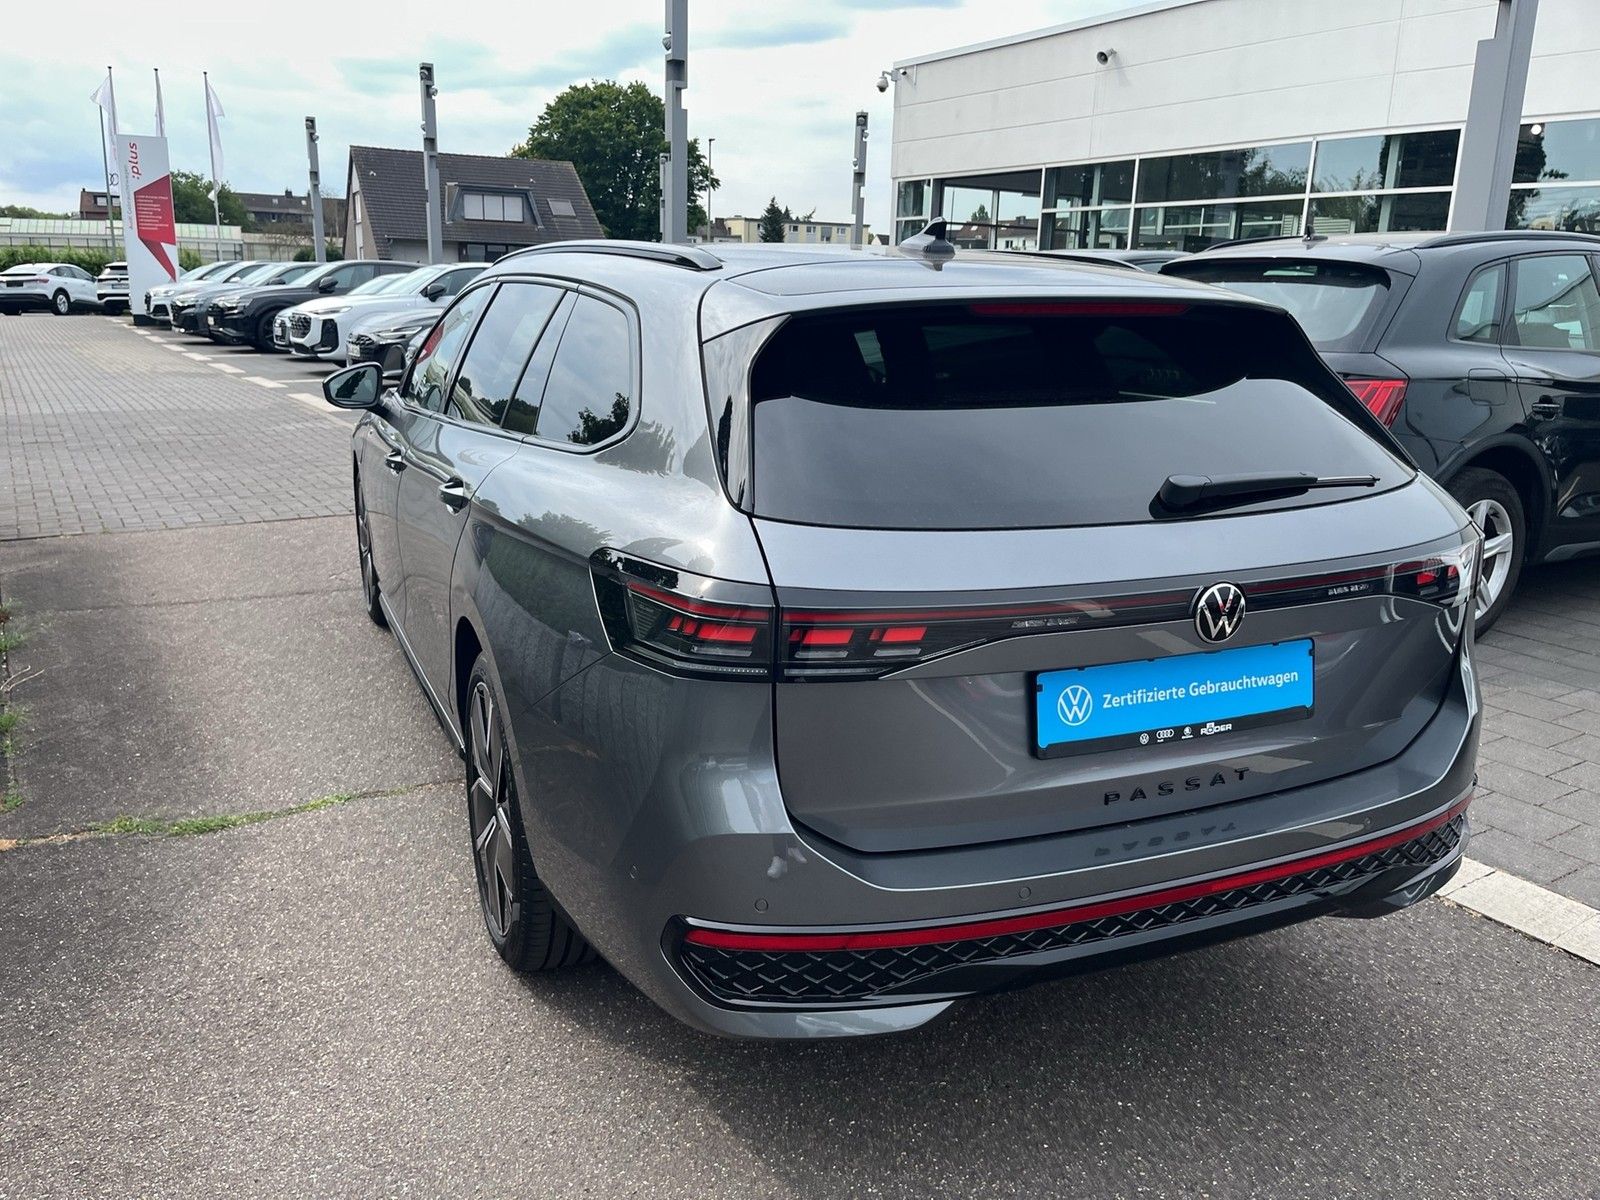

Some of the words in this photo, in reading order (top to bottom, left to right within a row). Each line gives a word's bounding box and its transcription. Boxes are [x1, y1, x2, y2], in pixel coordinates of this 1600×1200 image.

[1195, 581, 1246, 643] VW
[1102, 685, 1186, 709] Zertifizierte
[1189, 670, 1299, 696] Gebrauchtwagen
[1103, 767, 1250, 806] PASSAT
